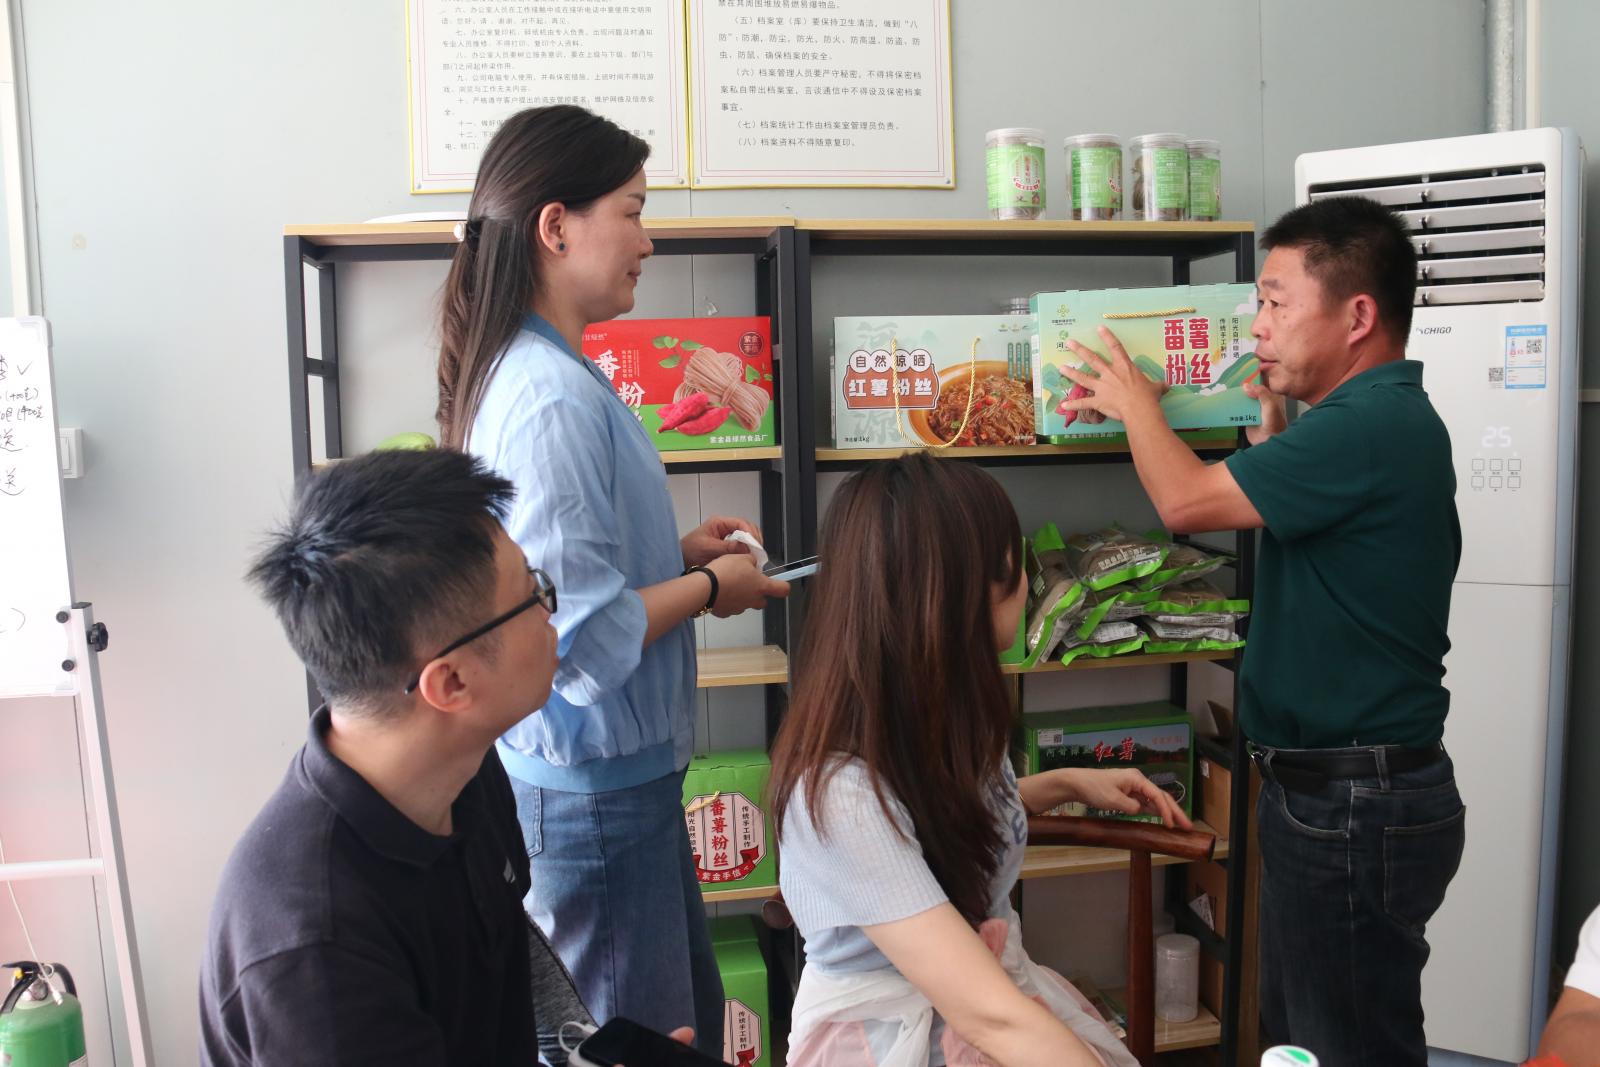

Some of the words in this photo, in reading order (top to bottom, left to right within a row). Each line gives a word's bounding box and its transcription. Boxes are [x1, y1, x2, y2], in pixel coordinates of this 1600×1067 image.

[1164, 318, 1209, 350] 番薯
[1423, 326, 1452, 335] CHIGO
[855, 354, 926, 368] 自然晾晒
[1165, 353, 1211, 386] 粉丝
[848, 378, 933, 398] 红薯粉丝
[1481, 425, 1512, 448] 25
[1094, 736, 1137, 762] 红薯
[710, 798, 729, 867] 番薯粉丝
